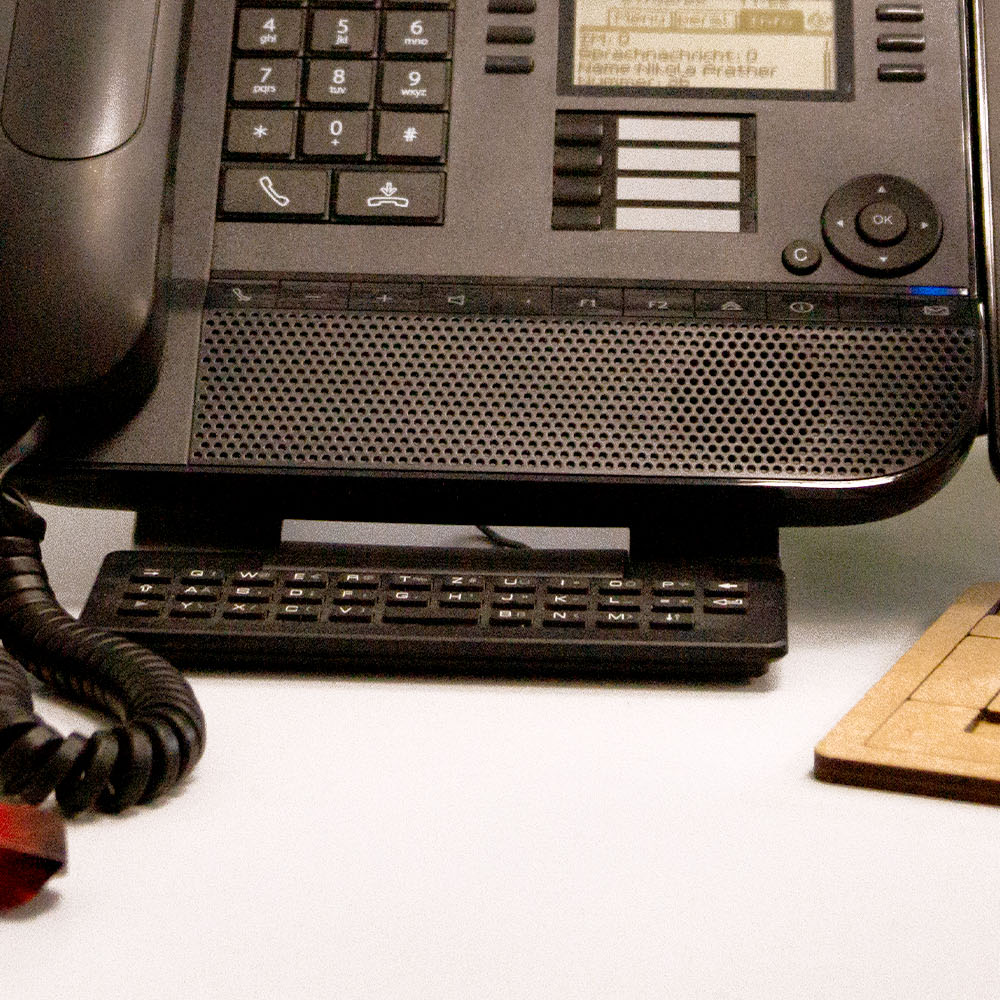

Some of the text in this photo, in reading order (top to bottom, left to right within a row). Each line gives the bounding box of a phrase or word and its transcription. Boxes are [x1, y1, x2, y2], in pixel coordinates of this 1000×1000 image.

[262, 18, 276, 32] 4
[337, 19, 349, 34] 5
[410, 20, 423, 35] 6
[259, 34, 277, 45] ghi
[404, 37, 429, 46] mno
[260, 67, 273, 83] 7
[332, 69, 345, 84] 8
[408, 71, 421, 87] 9
[253, 85, 276, 94] pqrs
[329, 85, 346, 94] tuv
[401, 88, 427, 97] wxyz
[329, 120, 343, 136] 0
[872, 214, 893, 225] OK
[793, 247, 808, 262] C
[648, 300, 668, 309] F2
[240, 571, 259, 579] W
[399, 575, 411, 583] T
[503, 578, 518, 586] U
[184, 586, 198, 594] A
[501, 593, 514, 601] J
[554, 595, 566, 603] K
[232, 603, 245, 611] X
[339, 606, 352, 614] V
[552, 611, 567, 619] N
